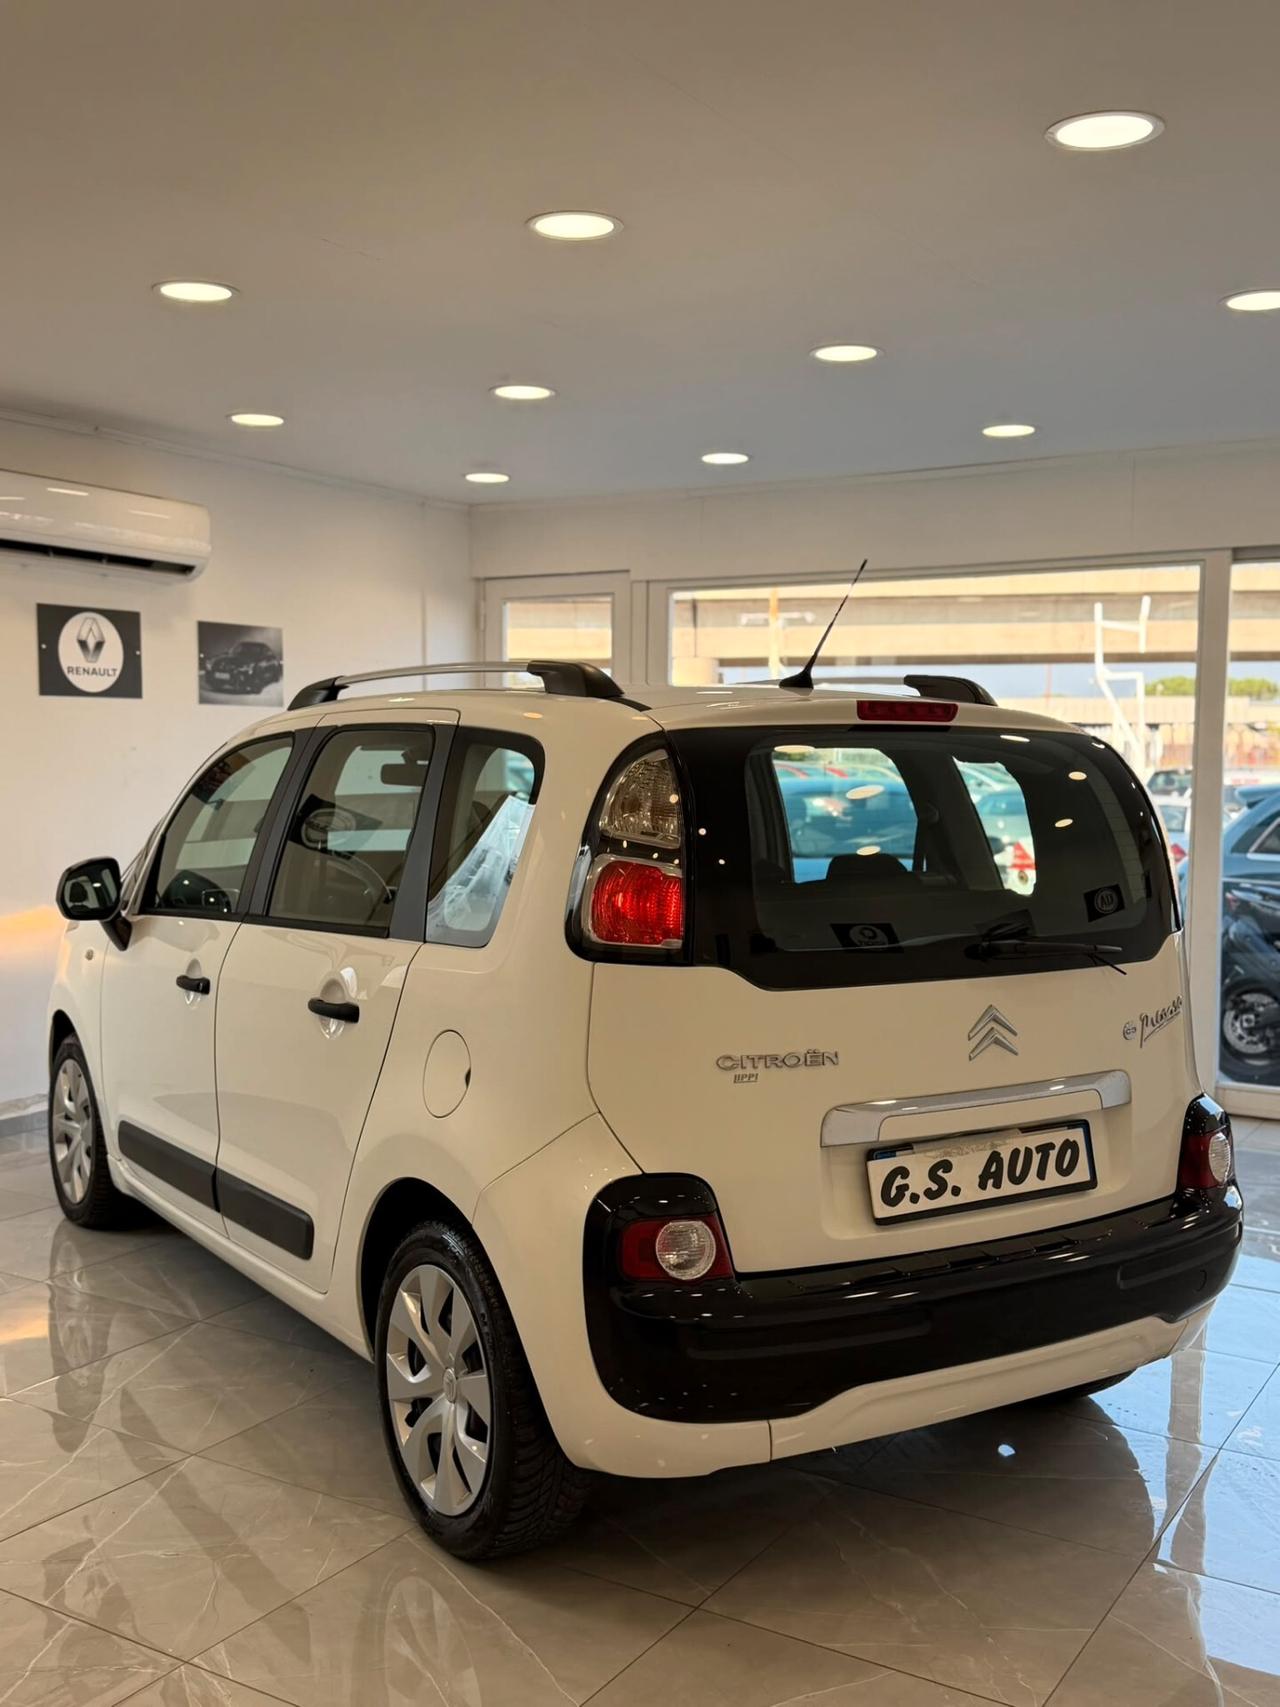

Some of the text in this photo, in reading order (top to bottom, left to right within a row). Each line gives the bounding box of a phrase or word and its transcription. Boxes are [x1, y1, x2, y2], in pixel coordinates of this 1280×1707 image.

[67, 666, 117, 677] RENAULT
[716, 1048, 839, 1071] CITROËN
[880, 1138, 1080, 1208] G.S. AUTO
